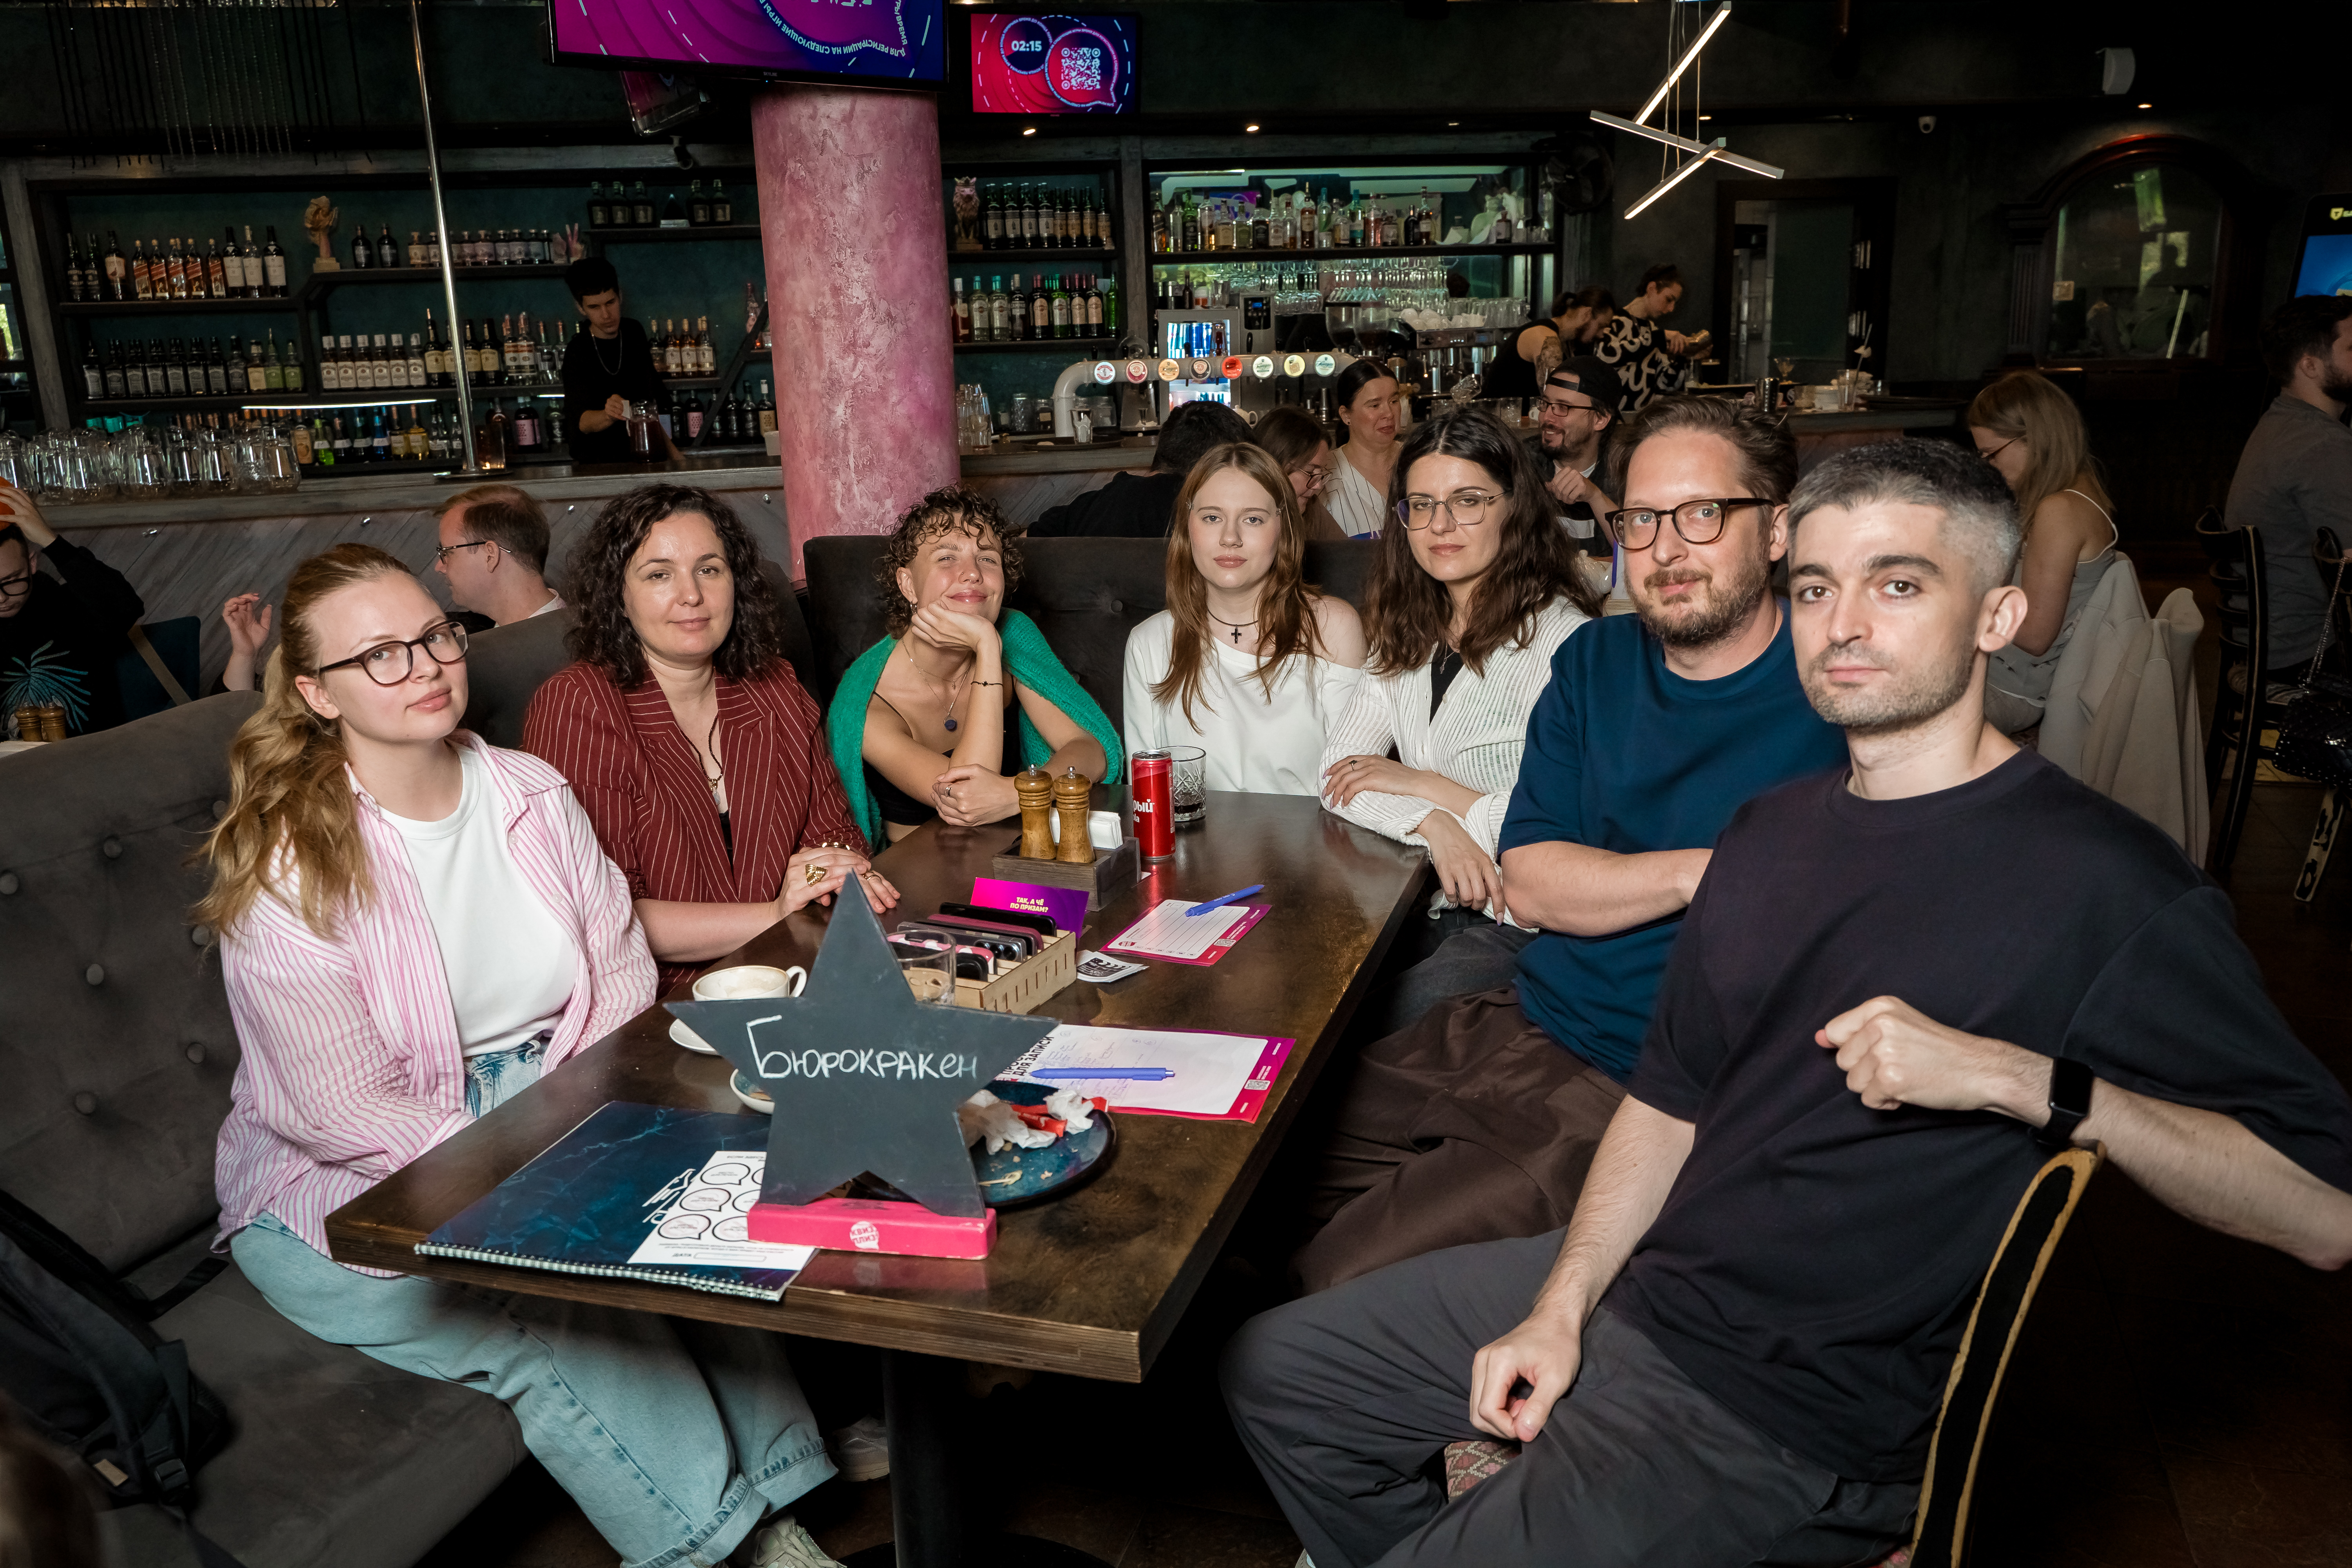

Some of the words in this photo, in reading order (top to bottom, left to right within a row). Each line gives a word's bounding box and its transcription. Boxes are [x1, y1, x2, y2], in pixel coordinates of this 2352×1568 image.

[763, 3, 782, 27] ИГРЫ
[896, 15, 907, 45] ВРЕМЯ
[781, 24, 830, 54] СЛЕДУЮЩИЕ
[843, 39, 889, 54] РЕГИСТРАЦИИ
[1011, 40, 1042, 52] 02:15
[890, 47, 906, 57] ДЛЯ
[1132, 798, 1154, 813] рый
[1020, 904, 1049, 913] ПРИЗАМ?
[1002, 1054, 1027, 1074] ПРОС
[1013, 1062, 1033, 1076] ДЛЯ
[1025, 1036, 1055, 1061] ЗАПИСИ
